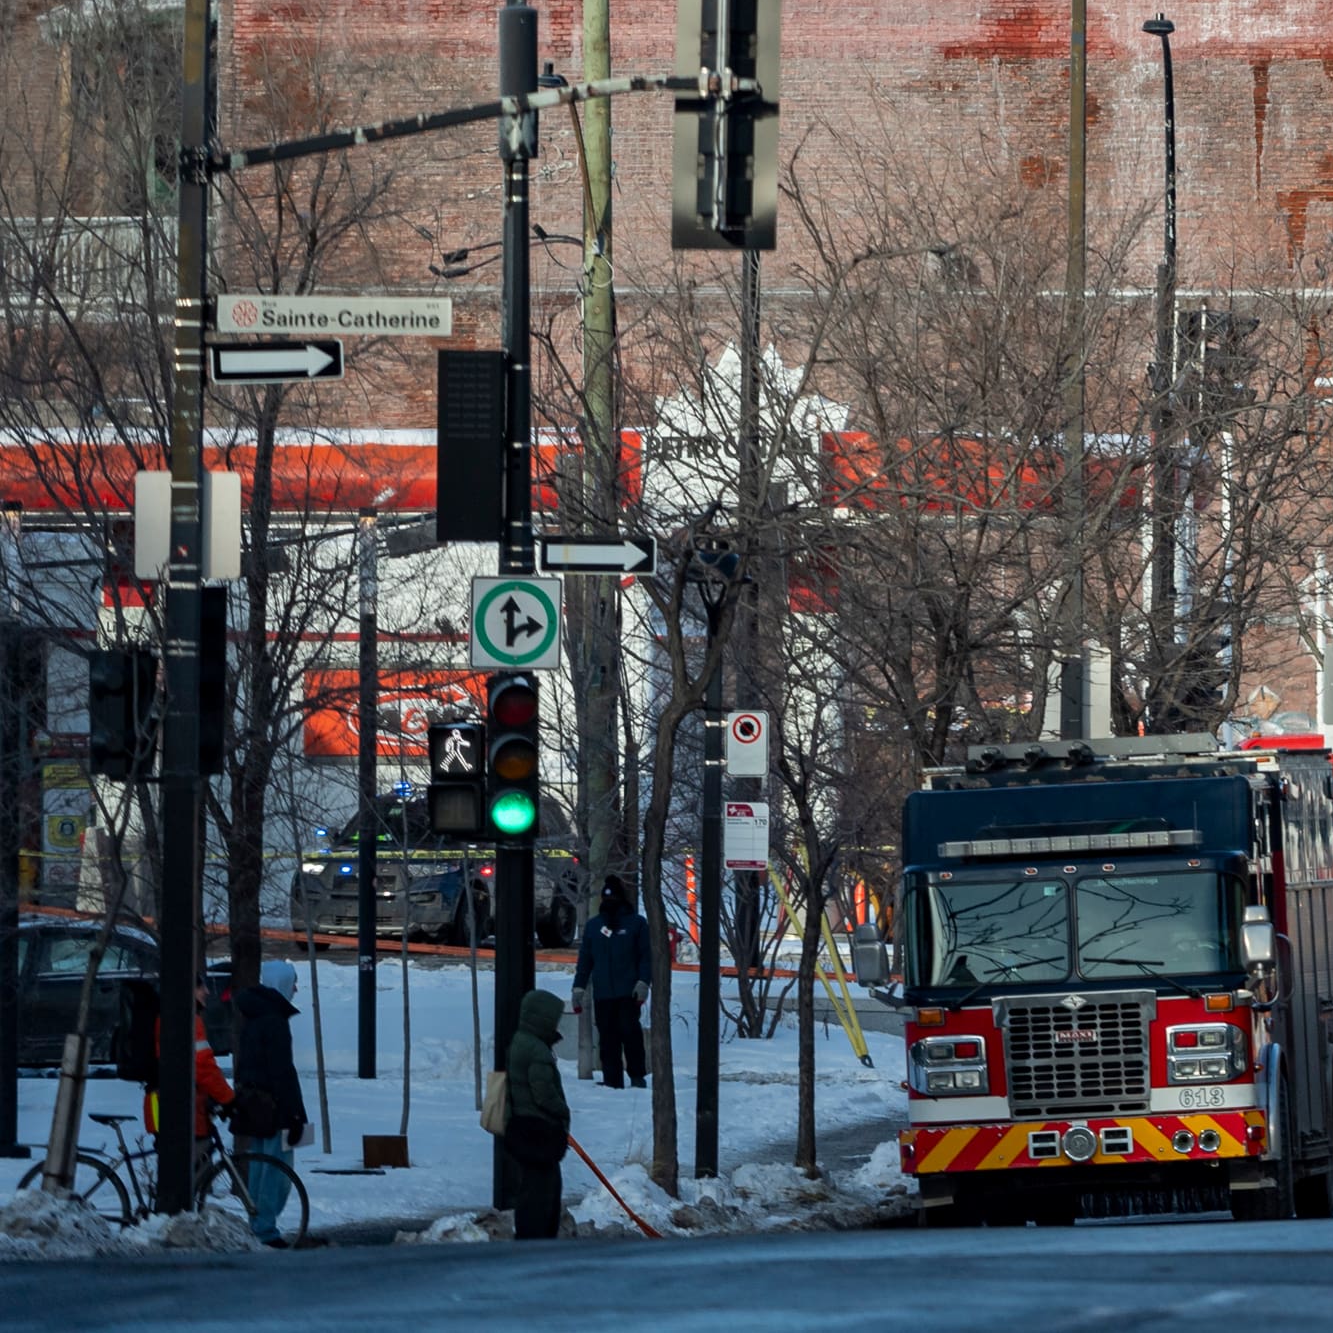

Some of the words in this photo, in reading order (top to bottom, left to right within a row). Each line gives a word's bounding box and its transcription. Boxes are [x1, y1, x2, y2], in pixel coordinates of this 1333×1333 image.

[261, 309, 441, 329] Sainte-Catherine
[754, 818, 768, 826] 170
[1179, 1087, 1225, 1108] 613
